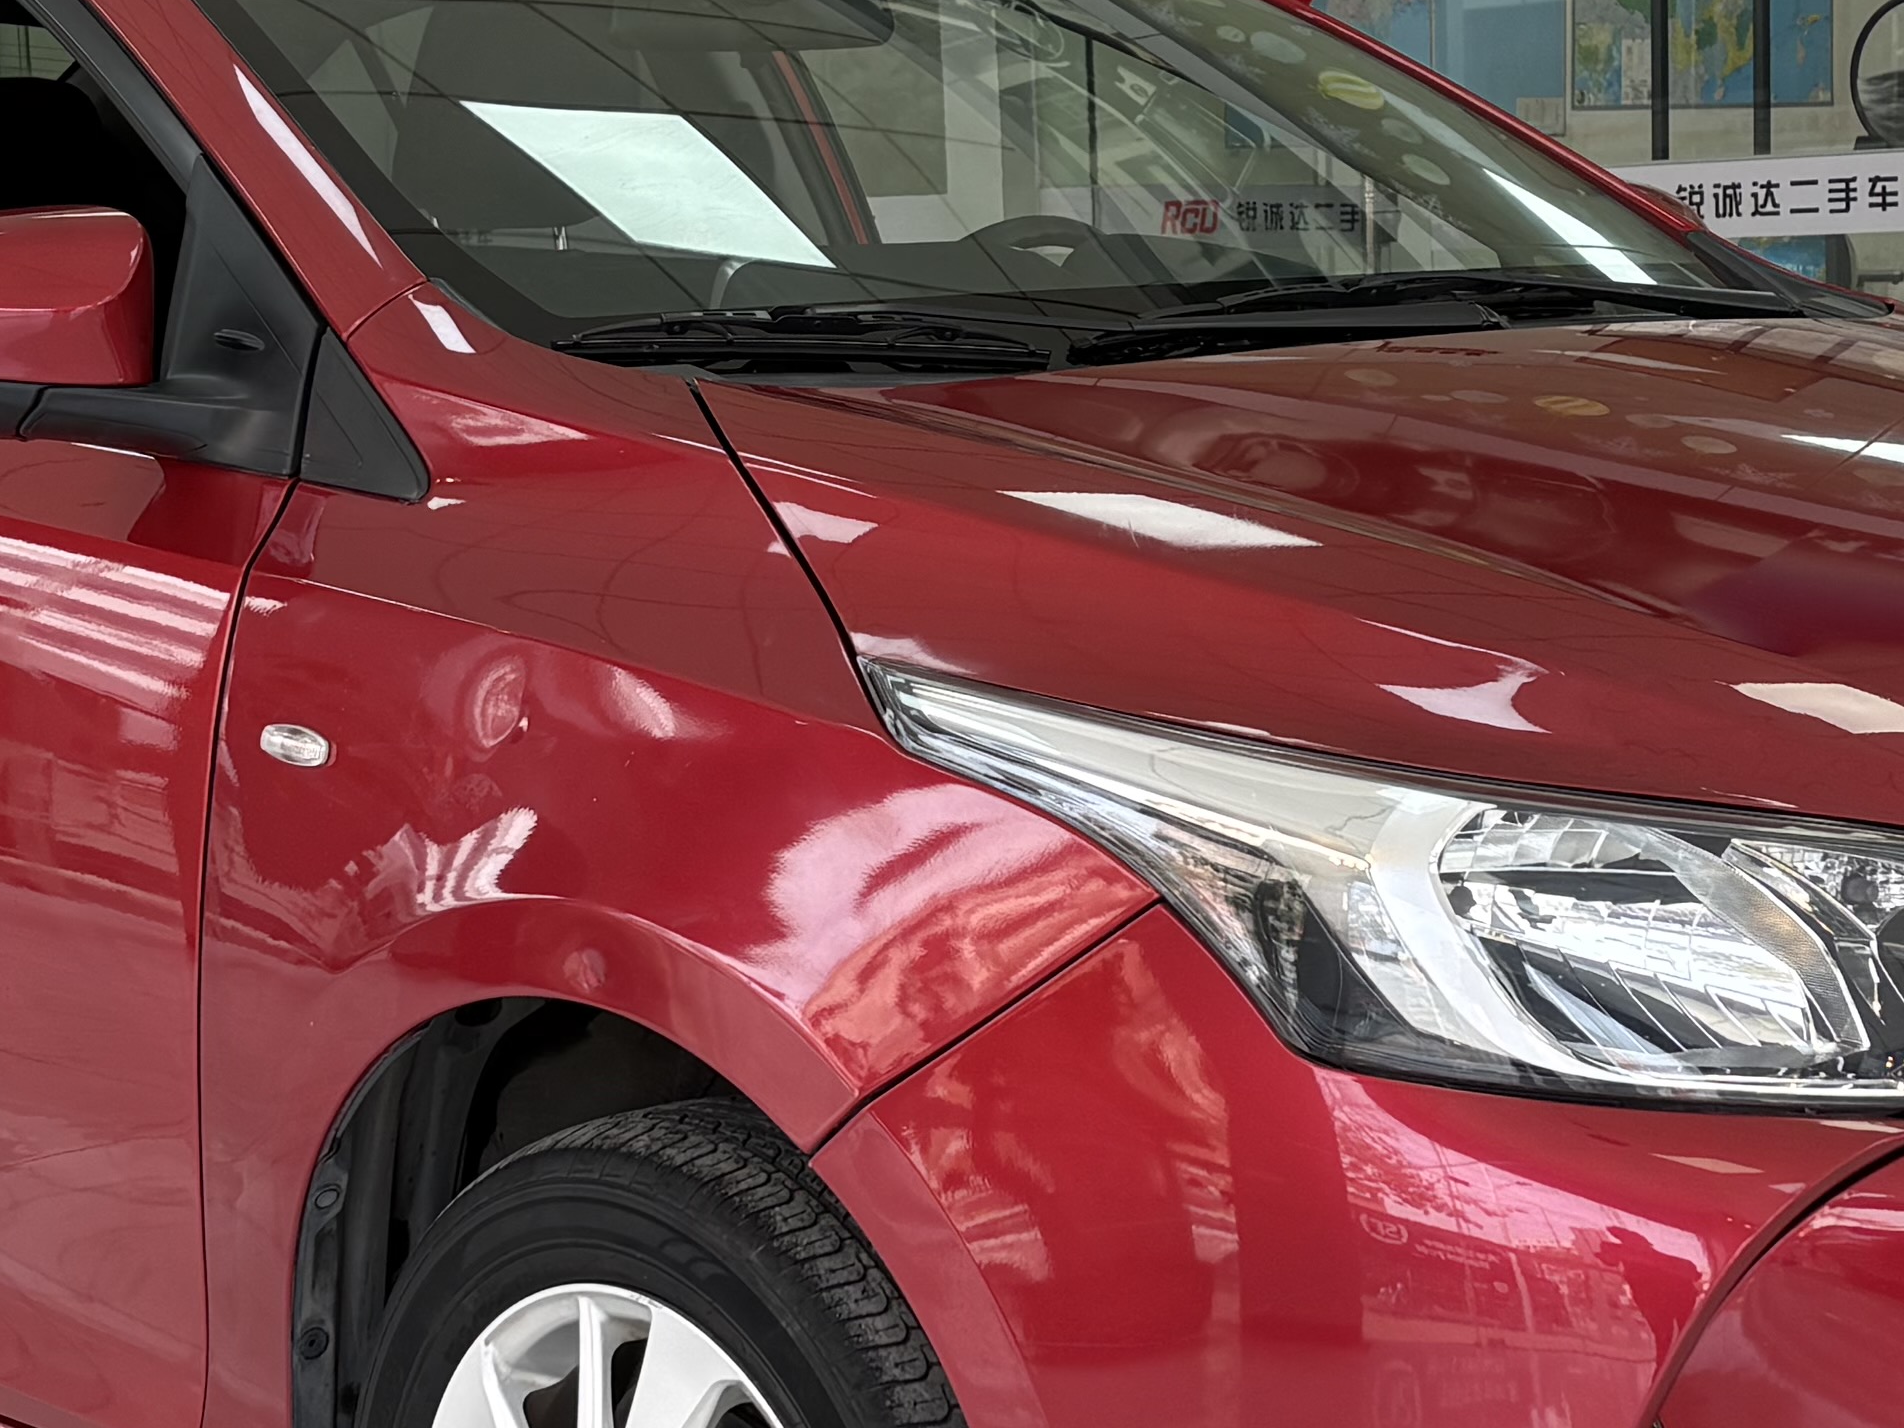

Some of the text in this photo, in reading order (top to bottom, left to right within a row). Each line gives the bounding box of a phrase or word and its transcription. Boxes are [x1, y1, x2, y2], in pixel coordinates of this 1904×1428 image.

[1675, 173, 1900, 221] 锐诚达二手车
